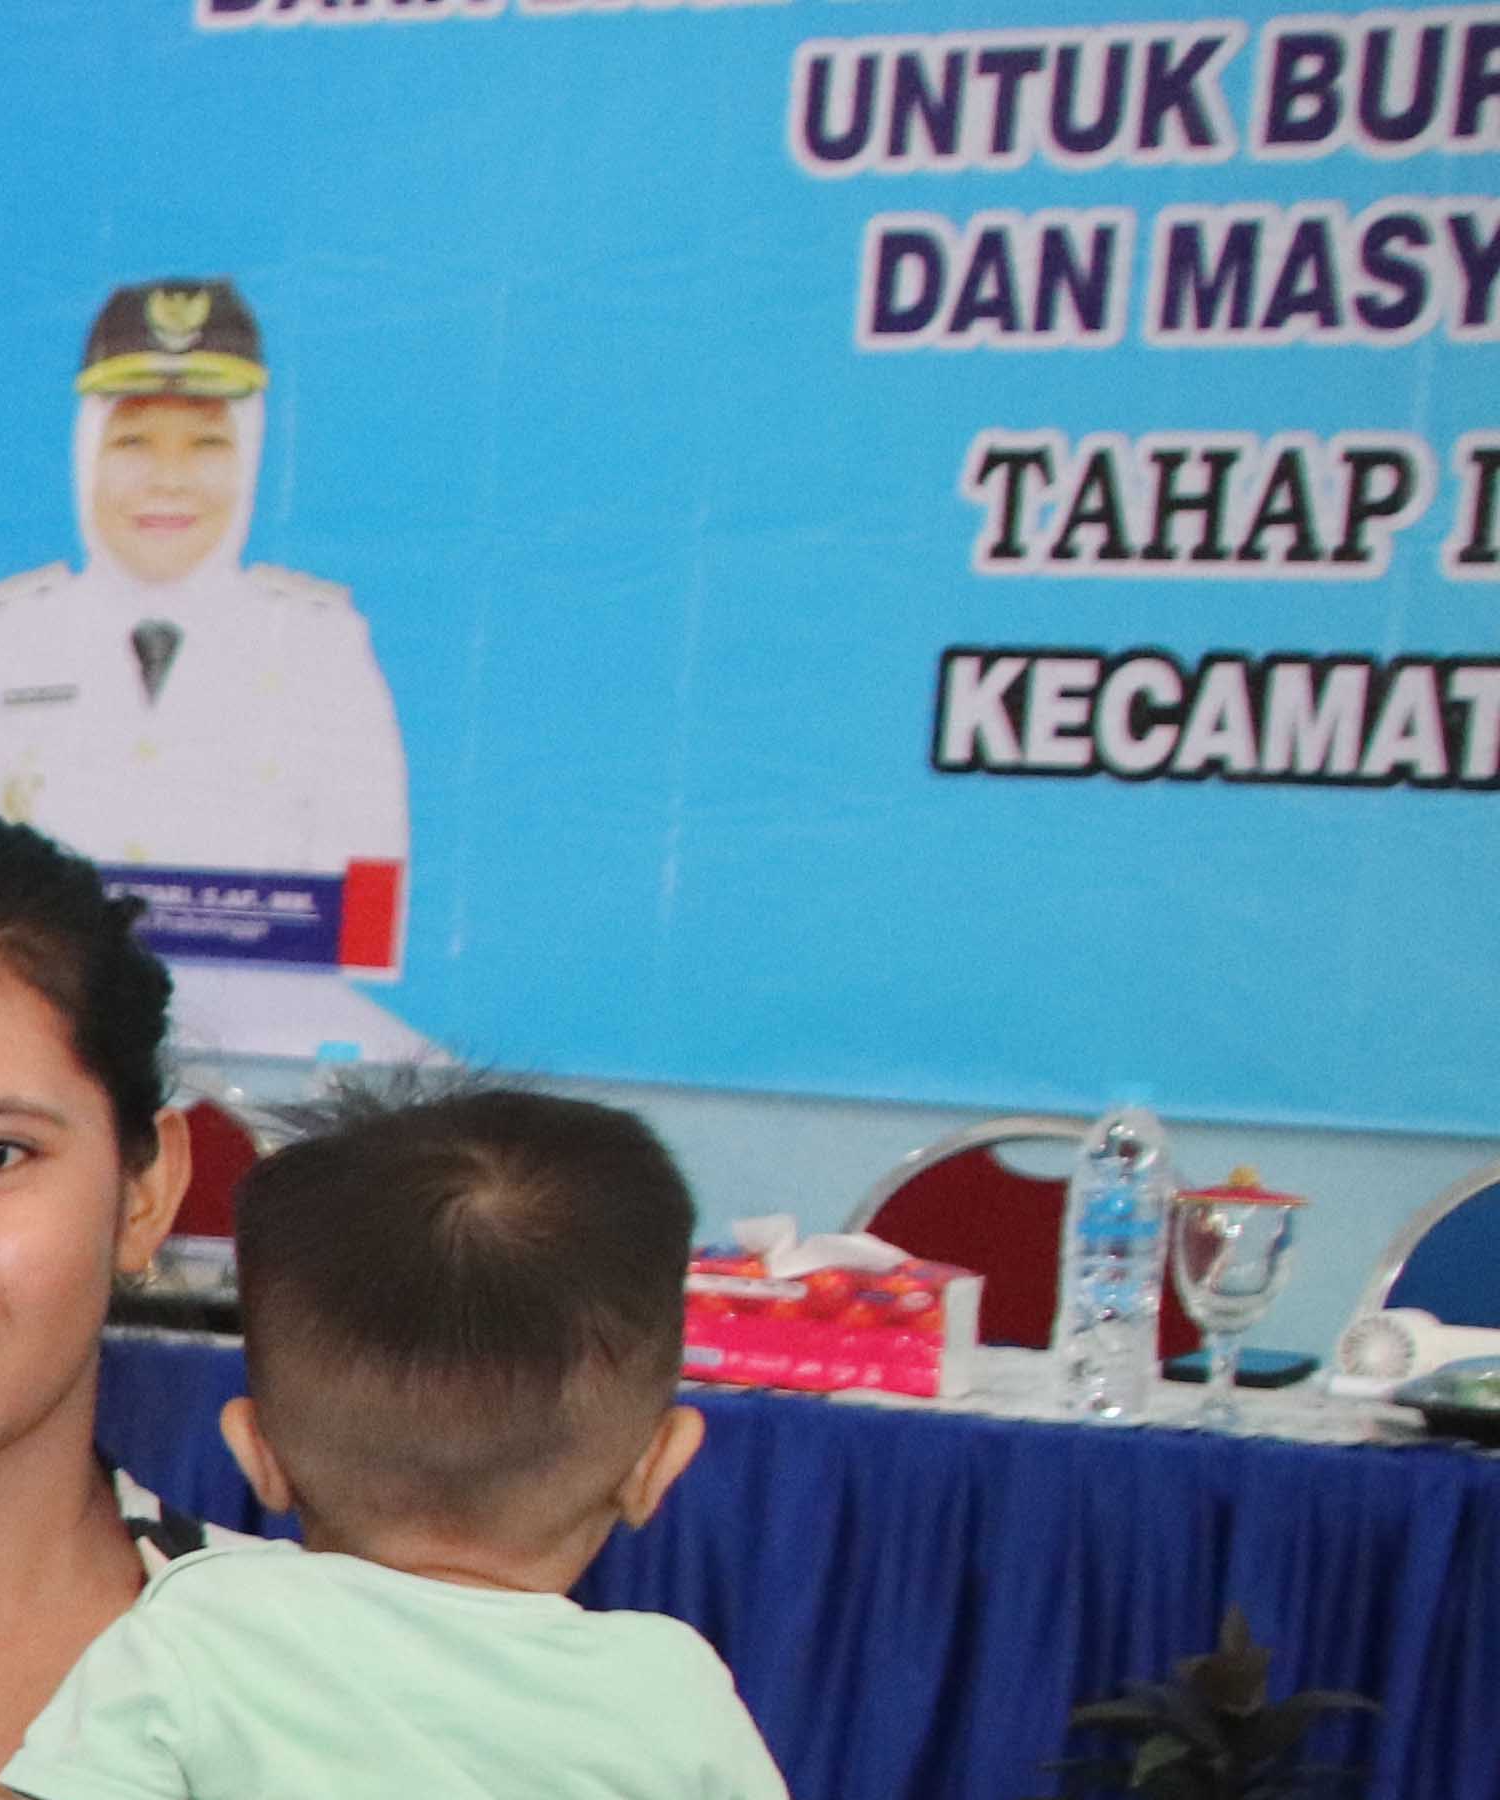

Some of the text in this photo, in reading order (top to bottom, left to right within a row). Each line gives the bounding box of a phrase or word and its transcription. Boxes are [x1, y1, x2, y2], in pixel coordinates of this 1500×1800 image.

[800, 34, 1230, 163] UNTUK
[870, 209, 1500, 336] DAN MASY
[975, 445, 1419, 563] TAHAP
[936, 652, 1500, 784] KECAMAT
